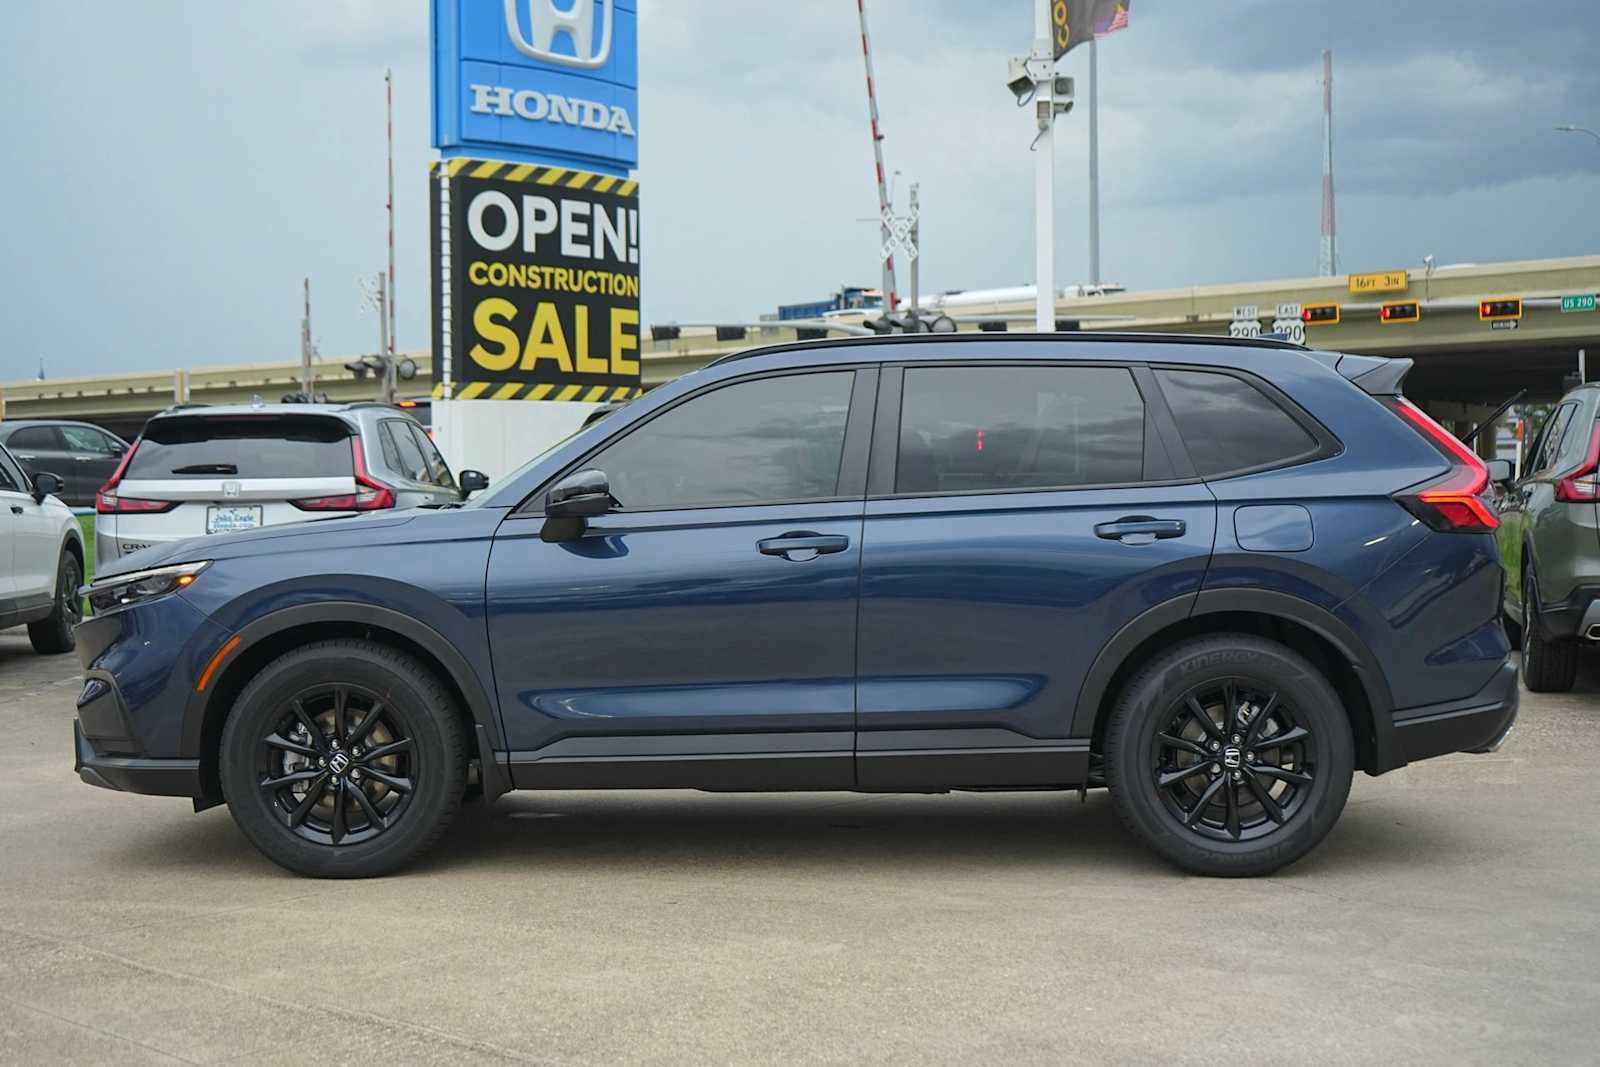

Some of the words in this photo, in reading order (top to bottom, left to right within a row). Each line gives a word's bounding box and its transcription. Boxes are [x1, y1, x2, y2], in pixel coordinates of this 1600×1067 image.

[469, 83, 636, 137] HONDA
[467, 189, 639, 264] OPEN!
[468, 260, 639, 299] CONSTRUCTION
[1577, 297, 1593, 307] 290
[469, 297, 640, 376] SALE
[1232, 326, 1259, 337] 290
